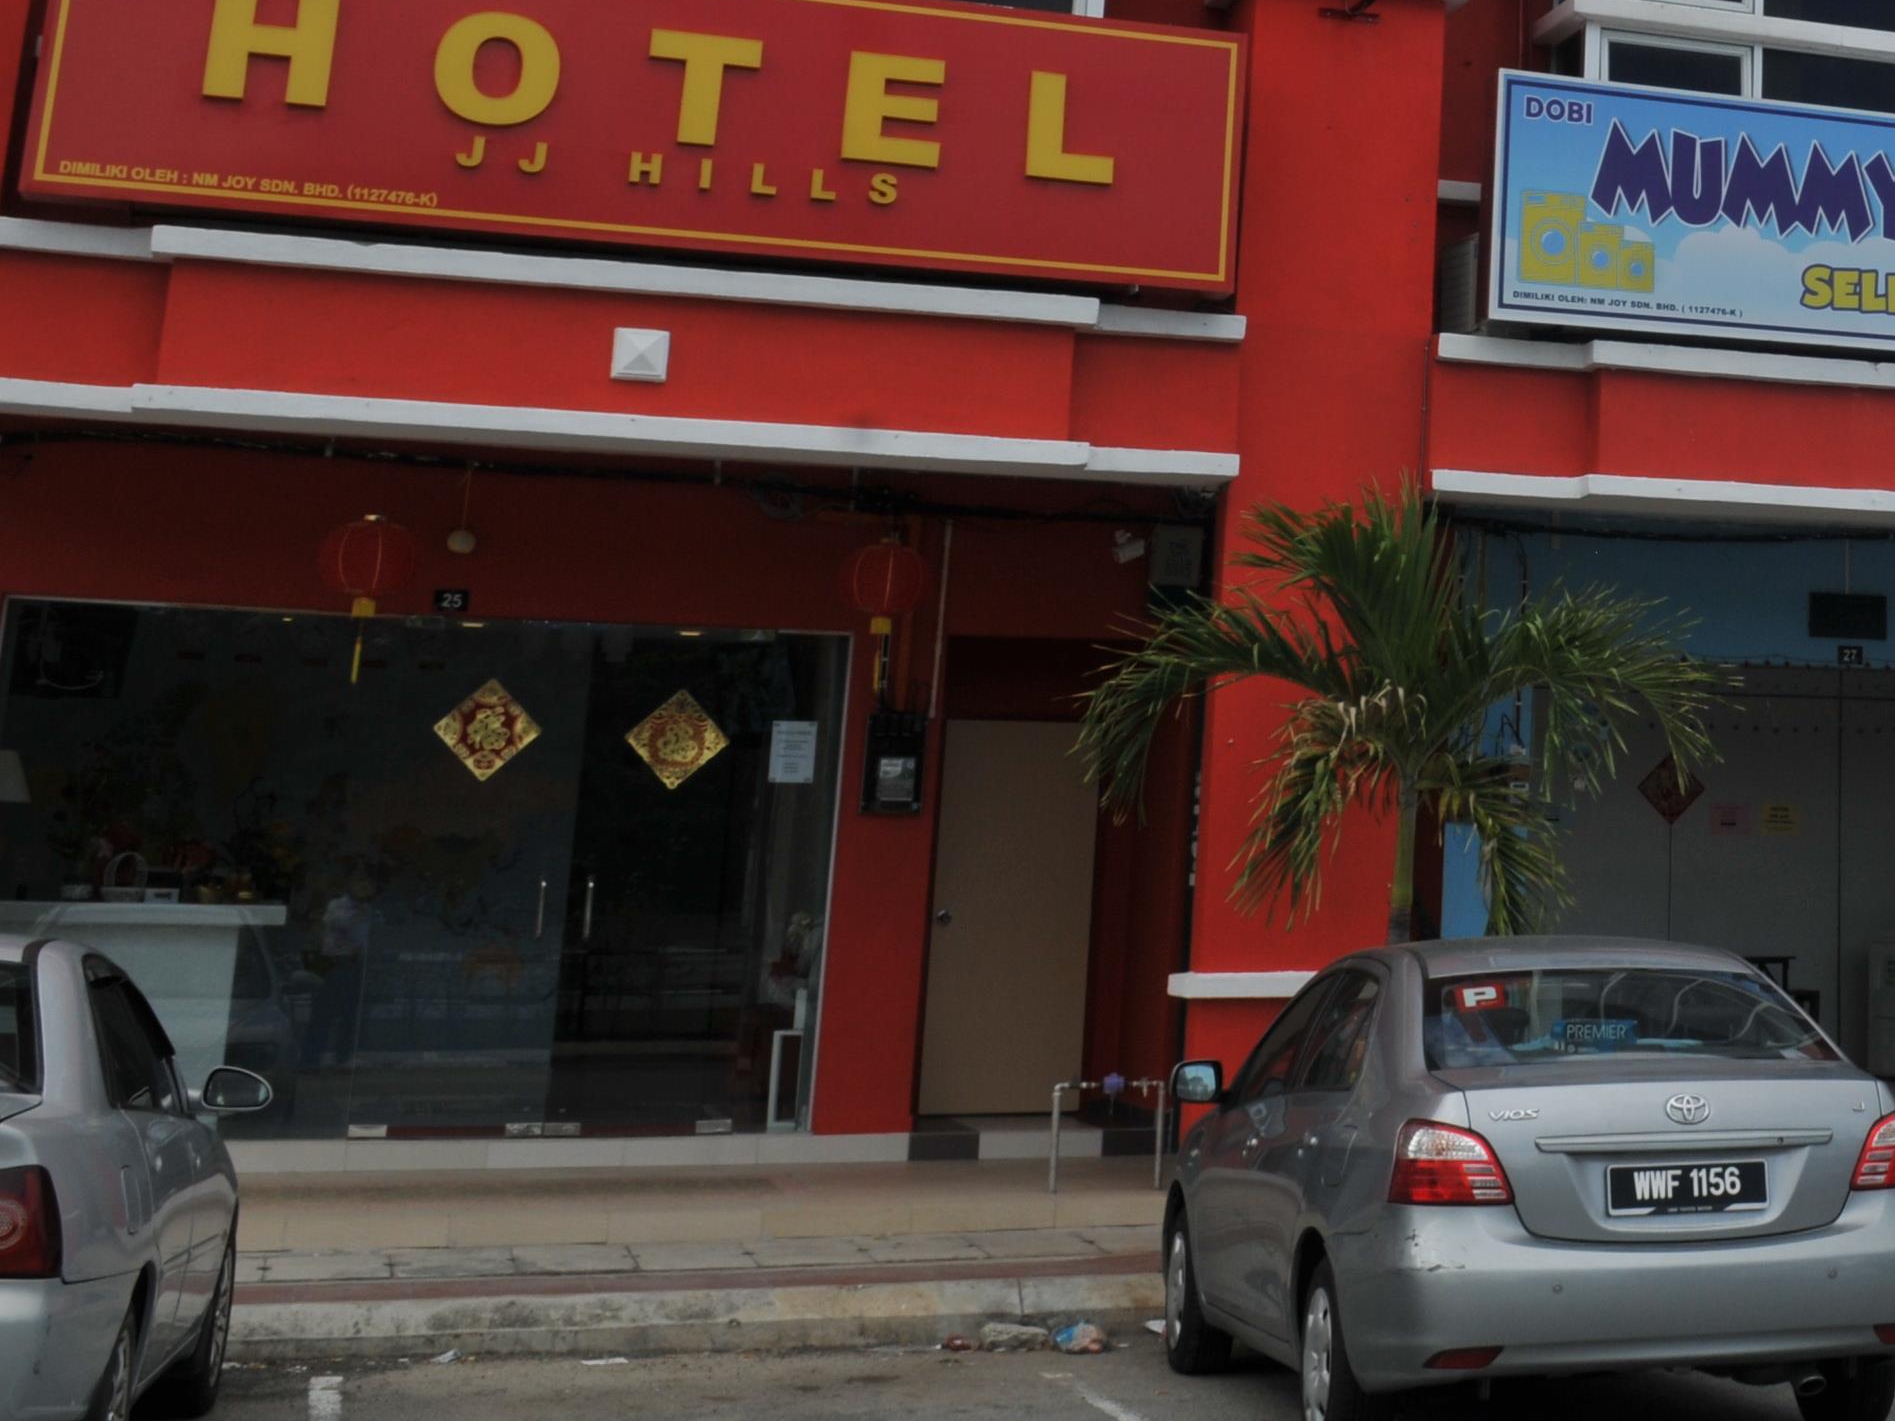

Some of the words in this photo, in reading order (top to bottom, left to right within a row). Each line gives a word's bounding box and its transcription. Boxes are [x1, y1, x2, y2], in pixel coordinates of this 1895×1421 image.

[1523, 96, 1593, 125] DOBI
[59, 160, 128, 180] DIMILIKI
[131, 167, 179, 184] OLEH
[192, 172, 219, 187] NM
[222, 175, 257, 190] JOY
[259, 178, 299, 195] SDN.
[303, 182, 343, 199] BHD.
[346, 184, 438, 208] (1127476-K)
[628, 150, 899, 206] HILLS
[1512, 290, 1555, 302] DIMILIKI
[1589, 298, 1606, 306] NM
[1607, 299, 1628, 309] JOY
[441, 592, 463, 609] 25
[1842, 648, 1858, 661] 27
[1462, 986, 1498, 1008] P
[1566, 1023, 1627, 1041] PREMIER
[1488, 1108, 1540, 1123] VIOS
[1633, 1169, 1683, 1201] WWF
[1689, 1166, 1742, 1198] 1156
